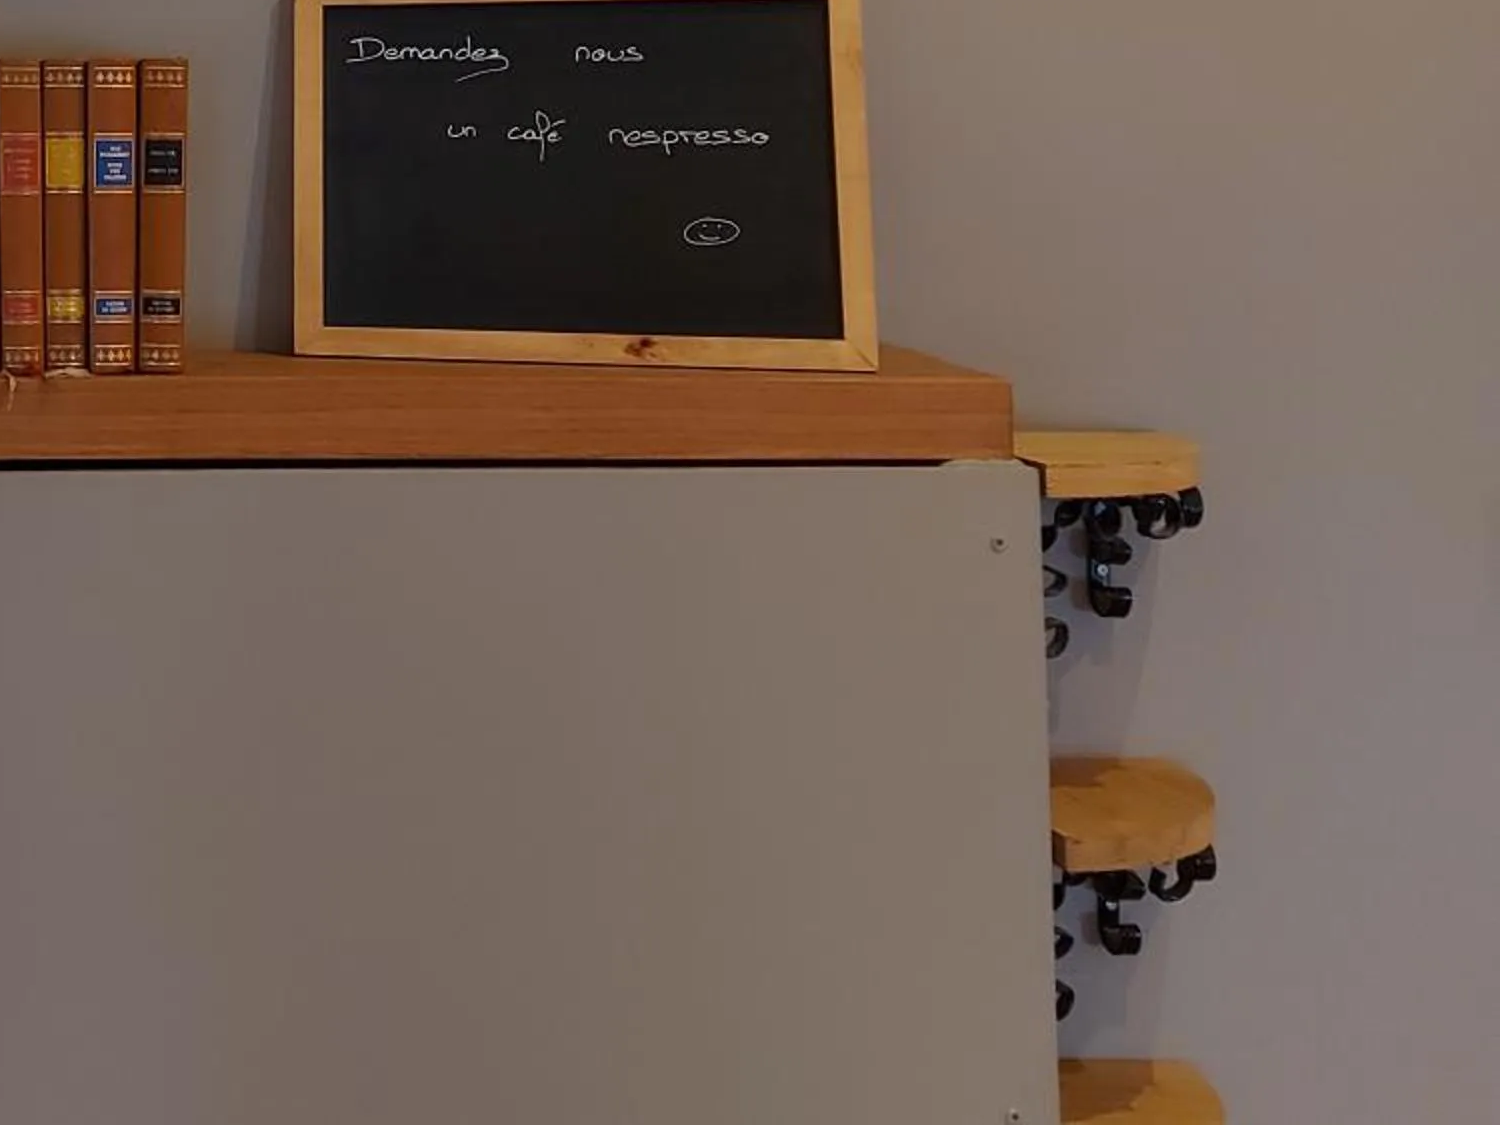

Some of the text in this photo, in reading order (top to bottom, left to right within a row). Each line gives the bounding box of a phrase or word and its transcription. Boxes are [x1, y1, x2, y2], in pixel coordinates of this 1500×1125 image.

[346, 36, 644, 82] Demandez nous
[447, 111, 769, 162] un café nespresso
